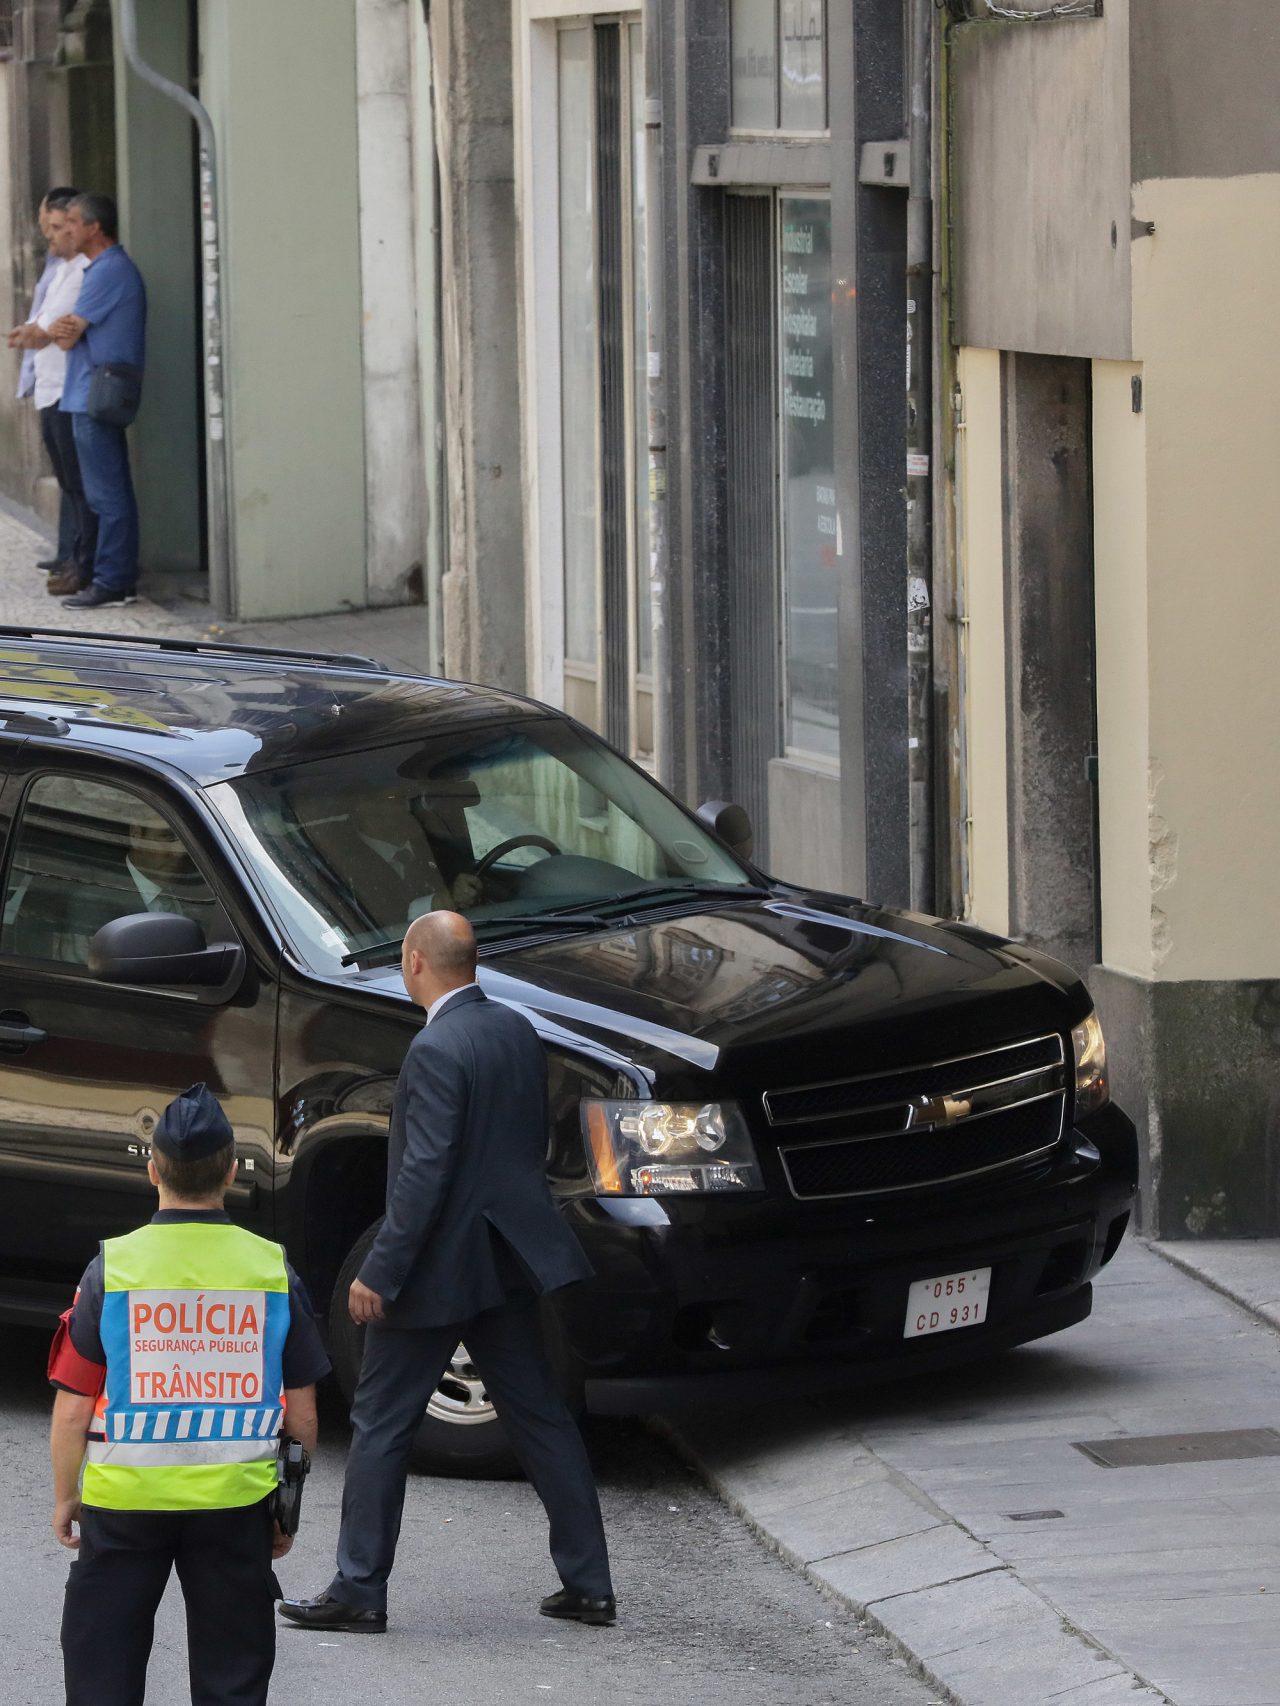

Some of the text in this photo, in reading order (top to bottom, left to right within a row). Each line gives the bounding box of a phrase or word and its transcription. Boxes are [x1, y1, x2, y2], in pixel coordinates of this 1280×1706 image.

[933, 1277, 966, 1298] 055
[133, 1294, 259, 1335] POLÍCIA
[916, 1303, 979, 1331] CD 931
[134, 1337, 259, 1355] SEGURANÇA PÚBLICA
[135, 1363, 259, 1399] TRÂNSITO
